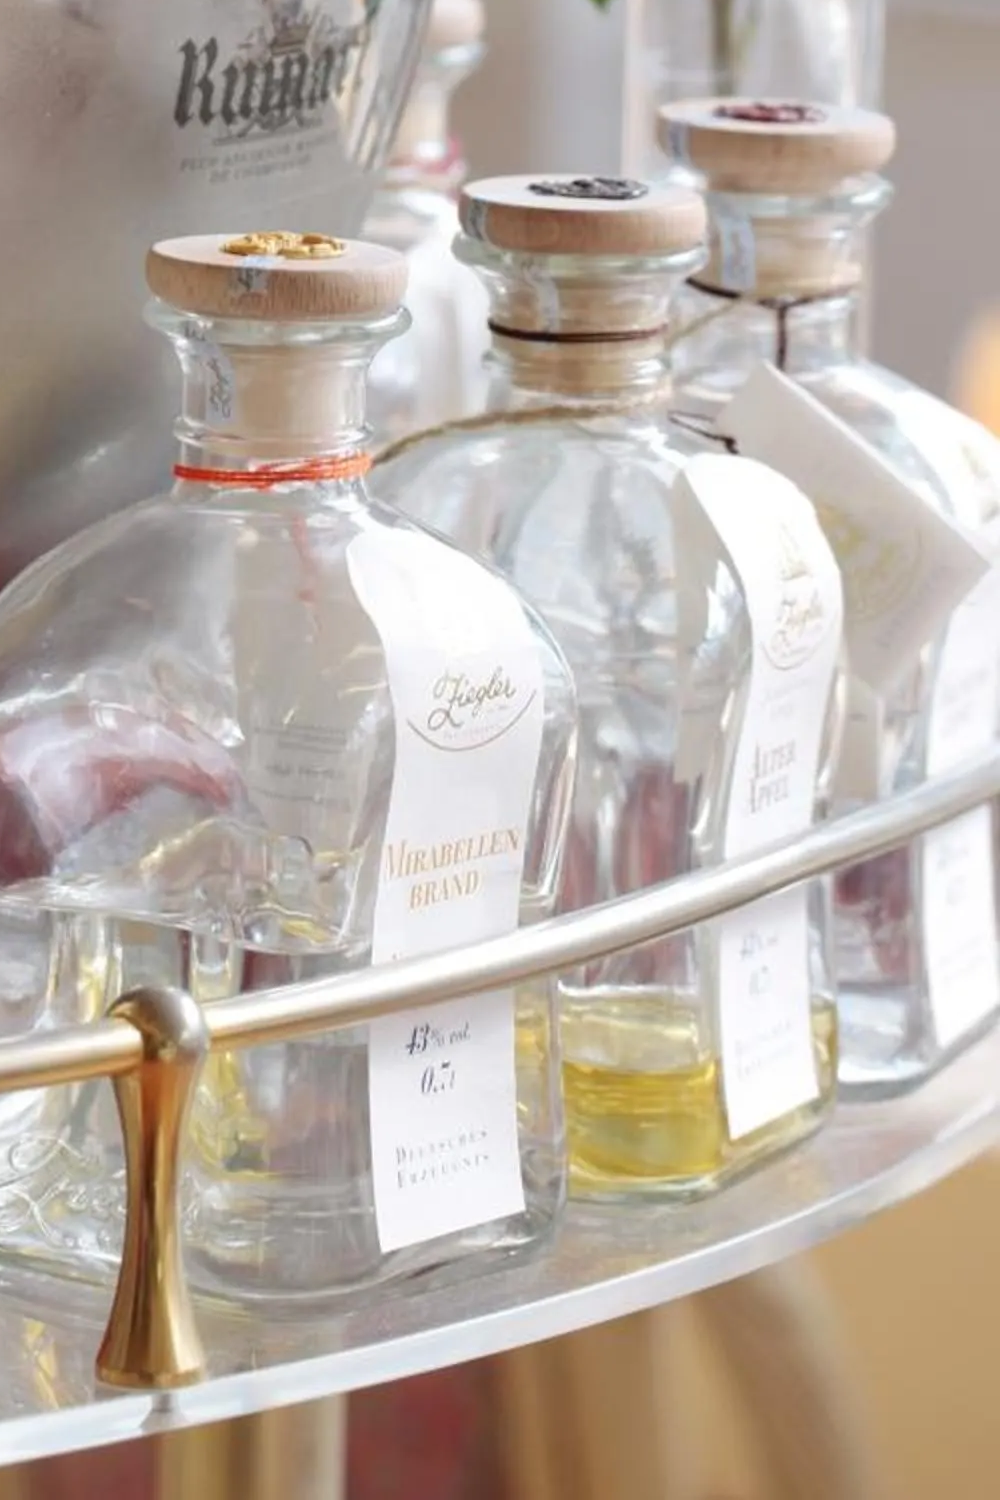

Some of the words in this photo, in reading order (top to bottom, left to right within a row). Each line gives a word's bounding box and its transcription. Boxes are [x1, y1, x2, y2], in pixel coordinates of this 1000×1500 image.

[427, 666, 518, 731] Ziegler
[385, 828, 521, 880] MIRABELLEN
[408, 869, 480, 910] BRAND
